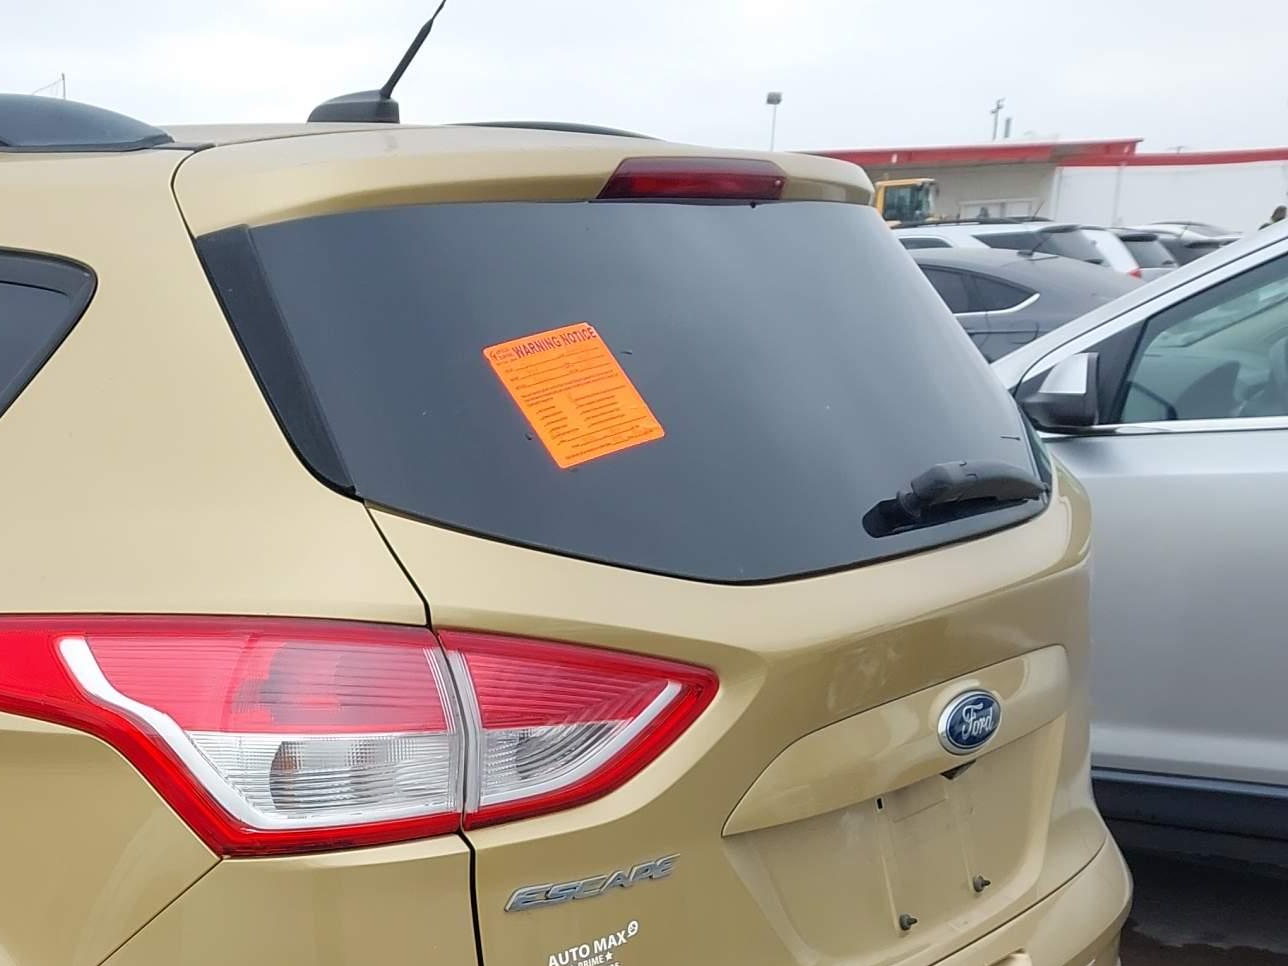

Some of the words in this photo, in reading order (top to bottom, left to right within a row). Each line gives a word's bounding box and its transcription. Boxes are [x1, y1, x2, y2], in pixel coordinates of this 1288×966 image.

[513, 336, 561, 359] WARNING
[560, 327, 597, 346] NOTICE
[961, 702, 994, 740] Ford
[504, 853, 680, 912] ESCAPE
[594, 930, 628, 954] MAX
